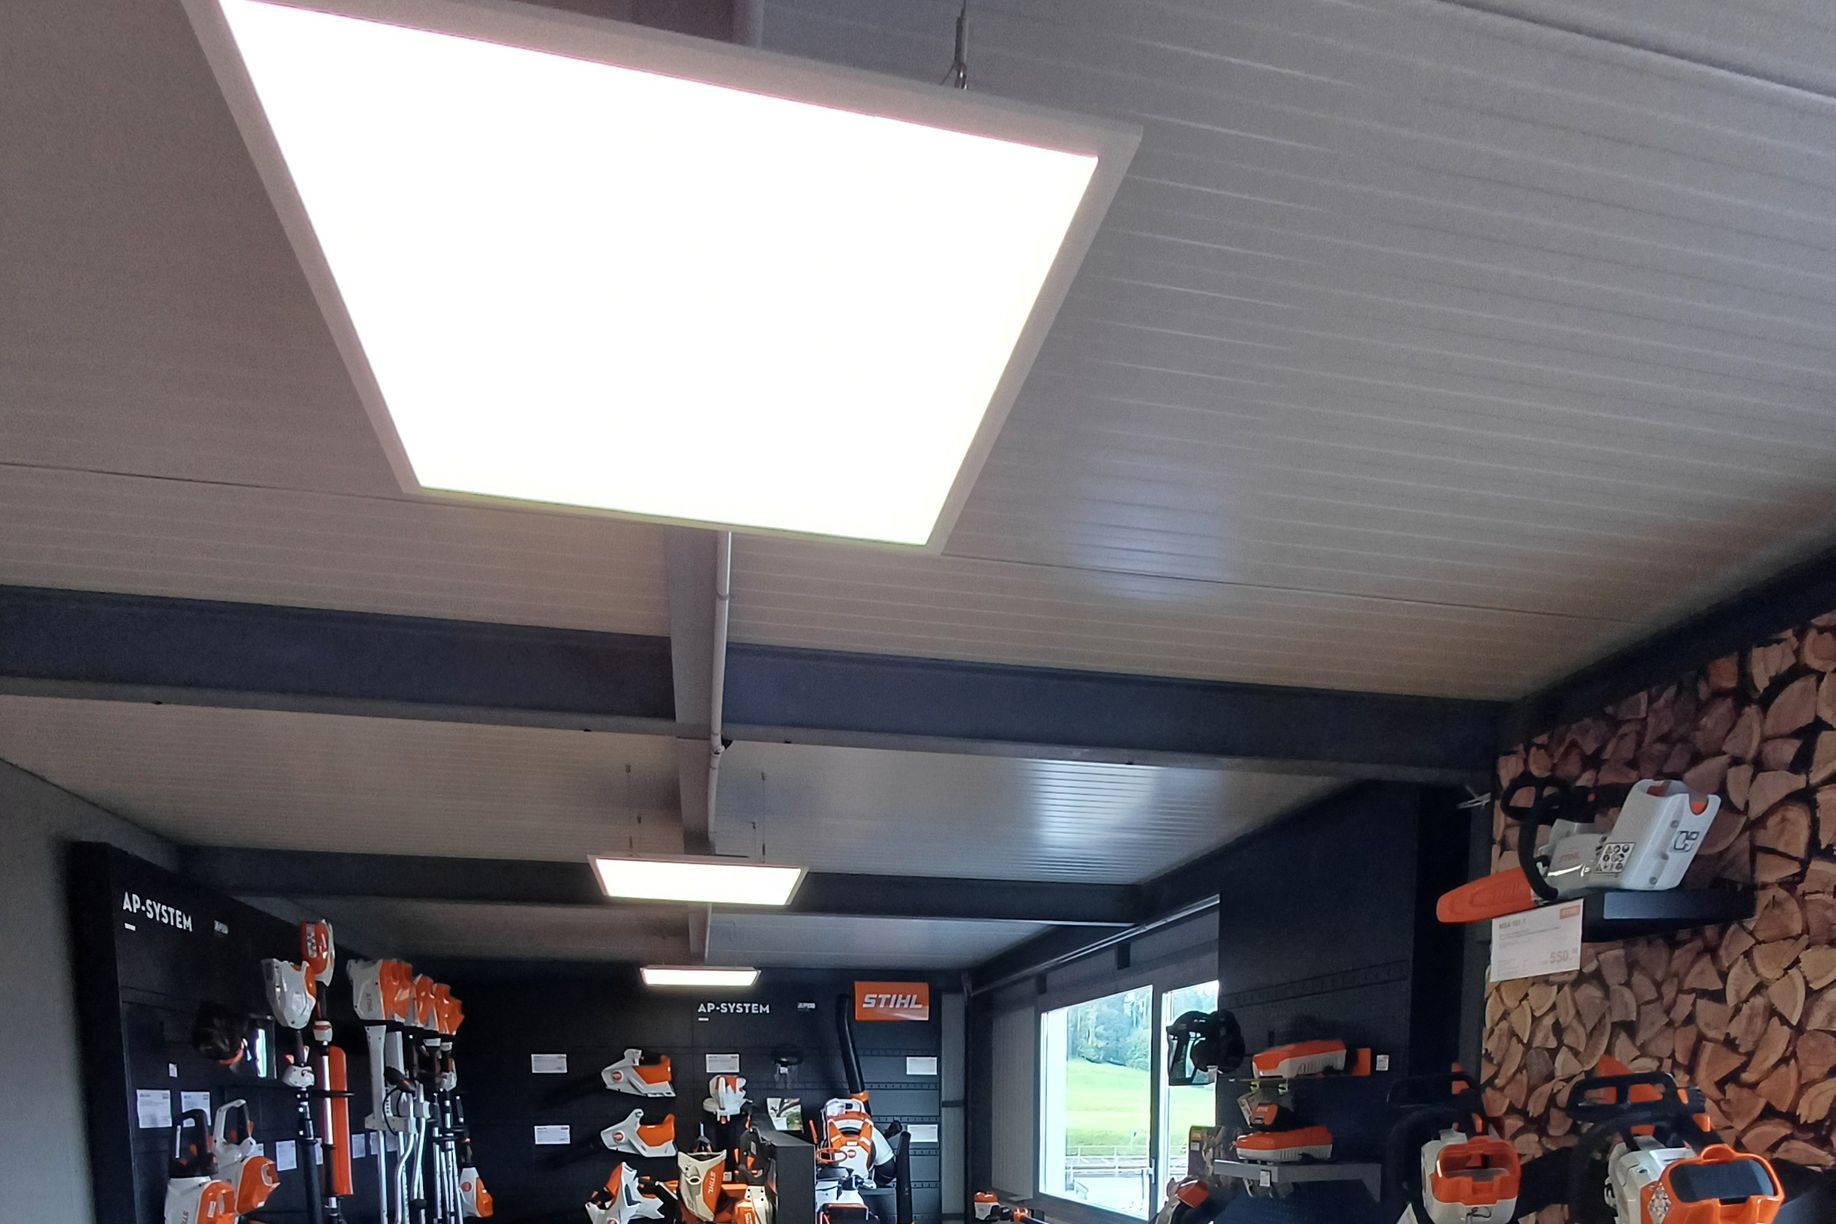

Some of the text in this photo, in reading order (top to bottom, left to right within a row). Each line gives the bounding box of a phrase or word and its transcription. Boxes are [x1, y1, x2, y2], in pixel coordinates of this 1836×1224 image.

[122, 891, 193, 932] AP-SYSTEM
[698, 1003, 770, 1014] AP-SYSTEM
[862, 993, 924, 1010] STIHL
[707, 1171, 716, 1195] STIHL
